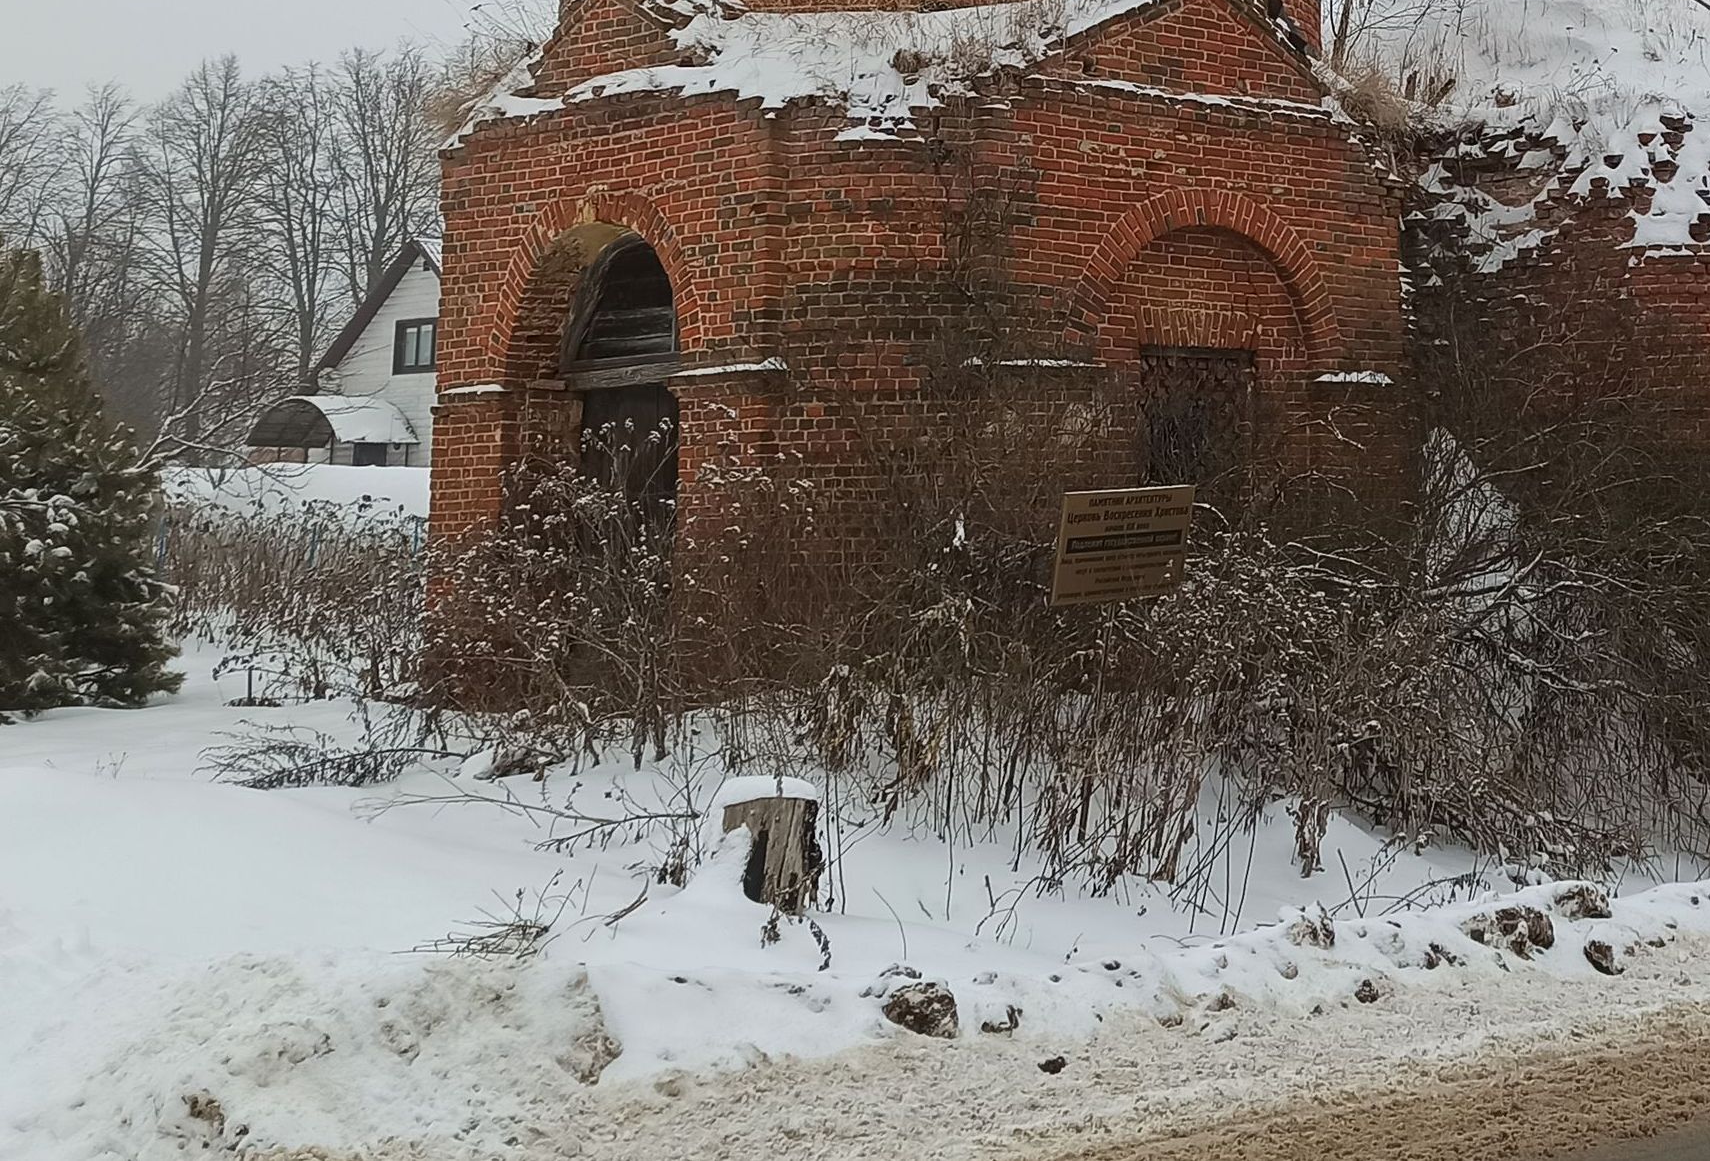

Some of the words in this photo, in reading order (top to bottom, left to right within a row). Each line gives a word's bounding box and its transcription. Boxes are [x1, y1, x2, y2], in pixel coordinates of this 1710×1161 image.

[1067, 512, 1101, 525] Церковь
[1103, 509, 1152, 521] Воскресения
[1154, 506, 1189, 518] Христова
